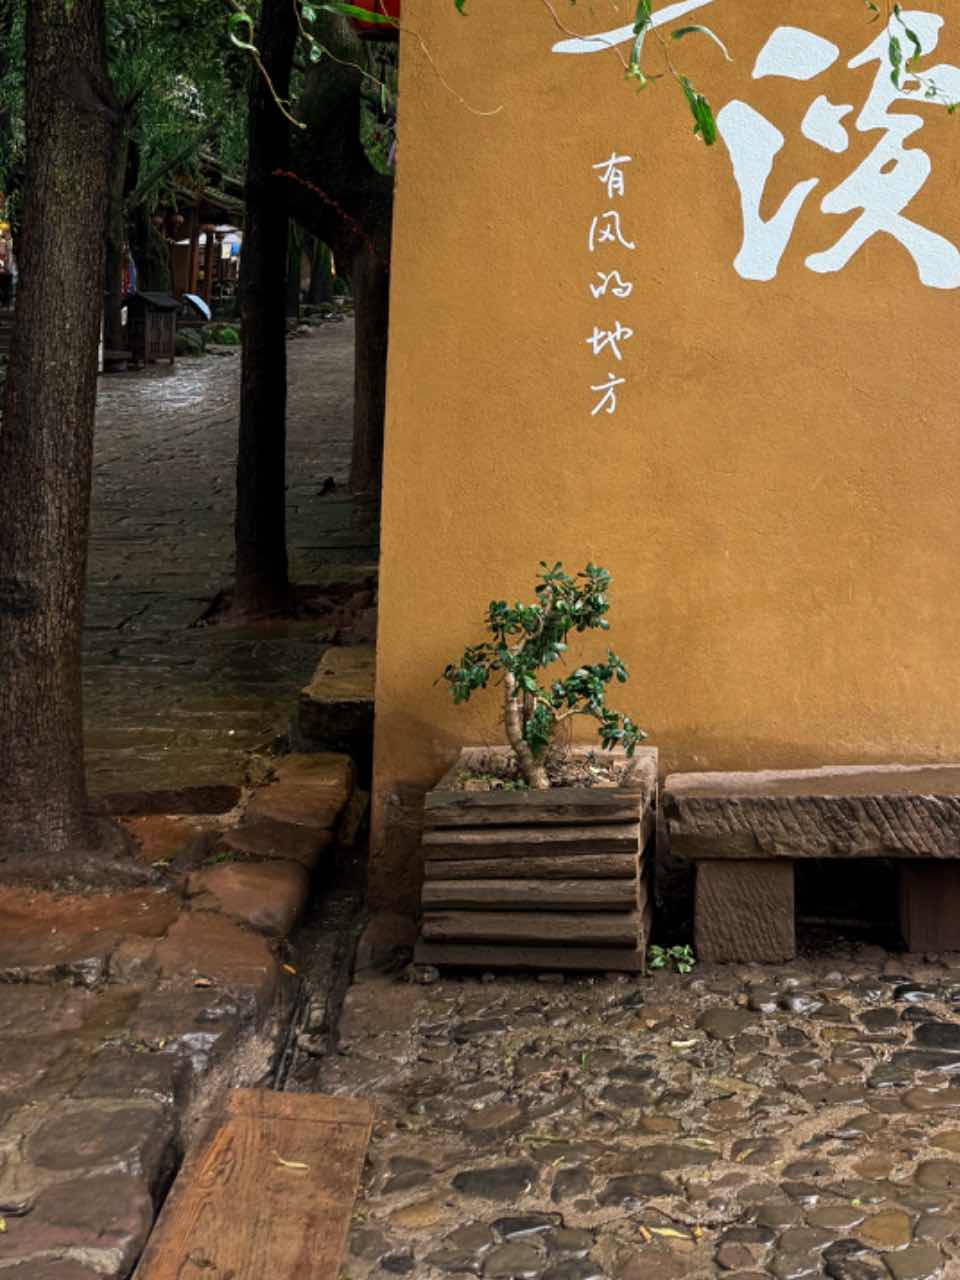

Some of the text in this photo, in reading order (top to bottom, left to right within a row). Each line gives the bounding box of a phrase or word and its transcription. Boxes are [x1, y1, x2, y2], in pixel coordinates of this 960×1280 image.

[585, 151, 637, 417] 有风的地方
